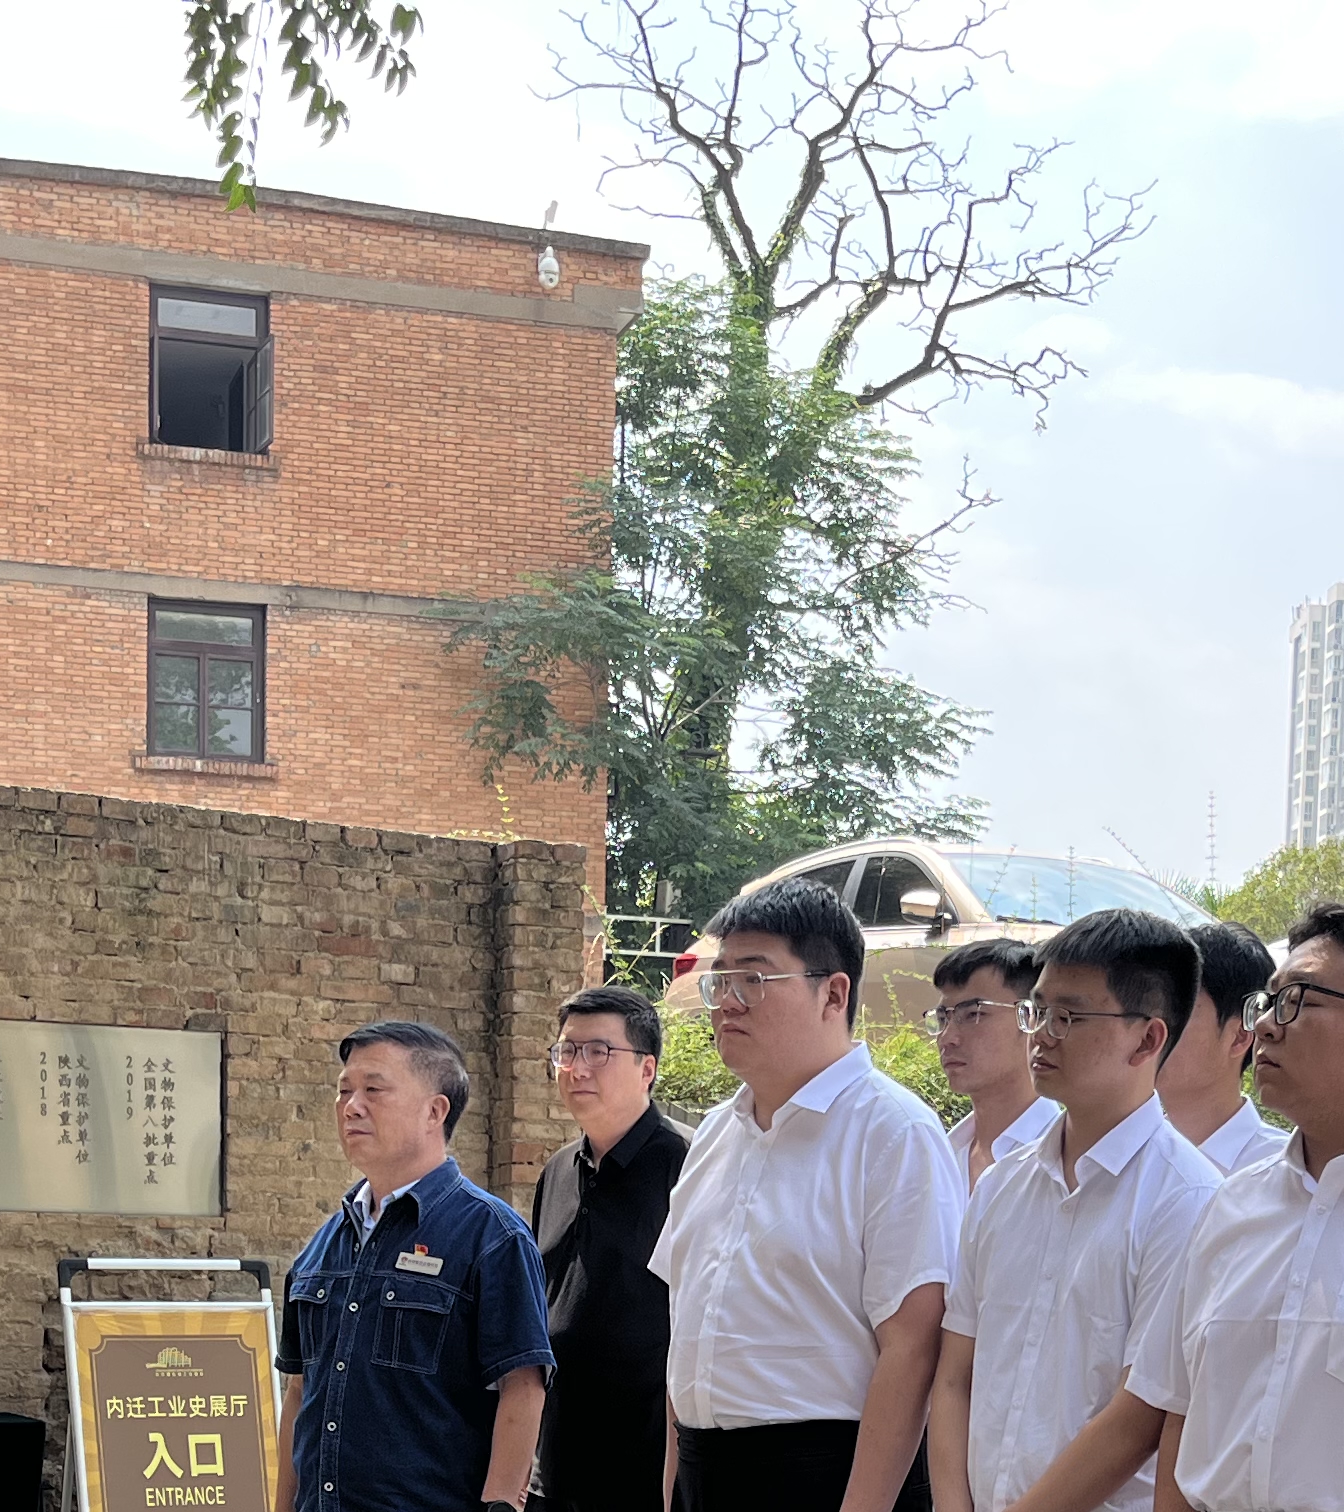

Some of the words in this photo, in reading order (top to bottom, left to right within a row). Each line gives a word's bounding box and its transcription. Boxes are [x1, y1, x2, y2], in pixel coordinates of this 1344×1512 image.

[39, 1051, 48, 1117] 2018
[57, 1053, 73, 1145] 陕西省重点
[74, 1054, 91, 1165] 文物保护单位
[125, 1055, 134, 1121] 2019
[160, 1058, 176, 1167] 文物保护单位
[142, 1057, 159, 1185] 全国第八批重点
[106, 1395, 248, 1419] 内迁工业史展厅
[143, 1432, 224, 1479] 入口
[145, 1486, 226, 1507] ENTRANCE
